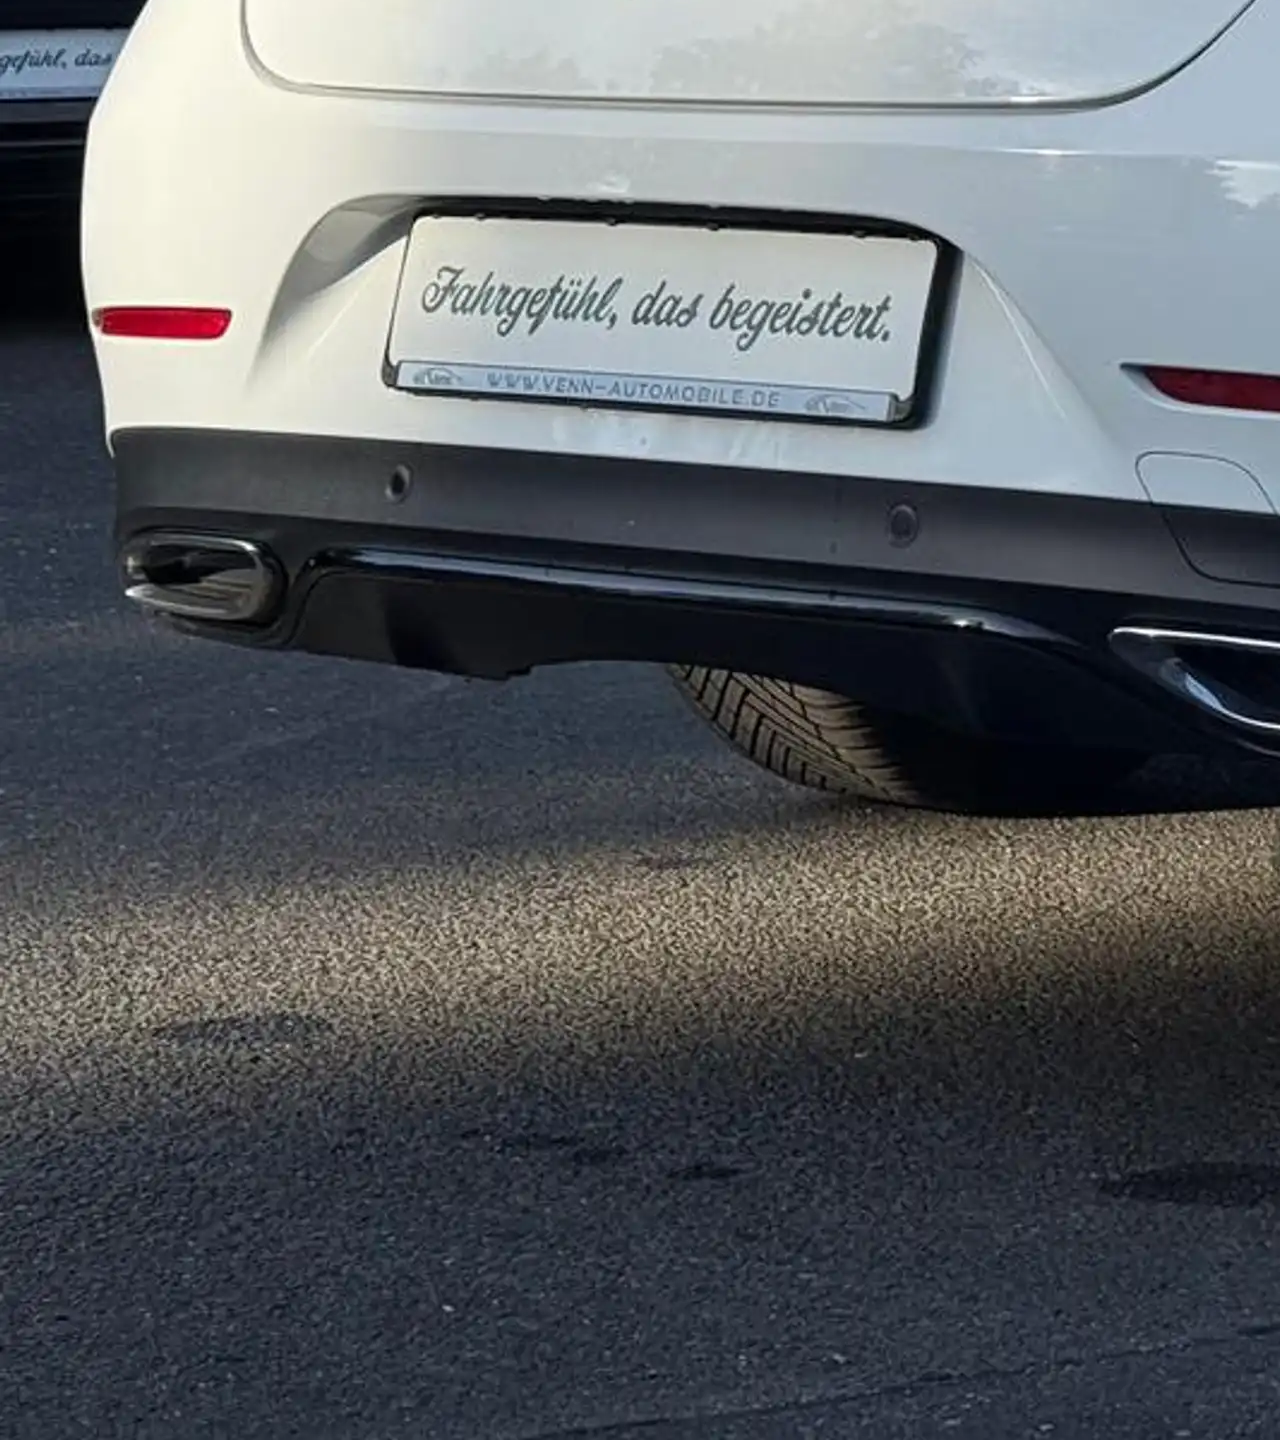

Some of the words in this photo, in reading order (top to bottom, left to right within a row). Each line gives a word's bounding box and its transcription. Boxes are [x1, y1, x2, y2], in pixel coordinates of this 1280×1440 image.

[421, 265, 625, 337] Fahrgefühl,
[631, 280, 704, 328] das
[709, 284, 894, 351] begeistert.
[485, 371, 781, 409] WWW.VENN-AUTOMOBILE.DE
